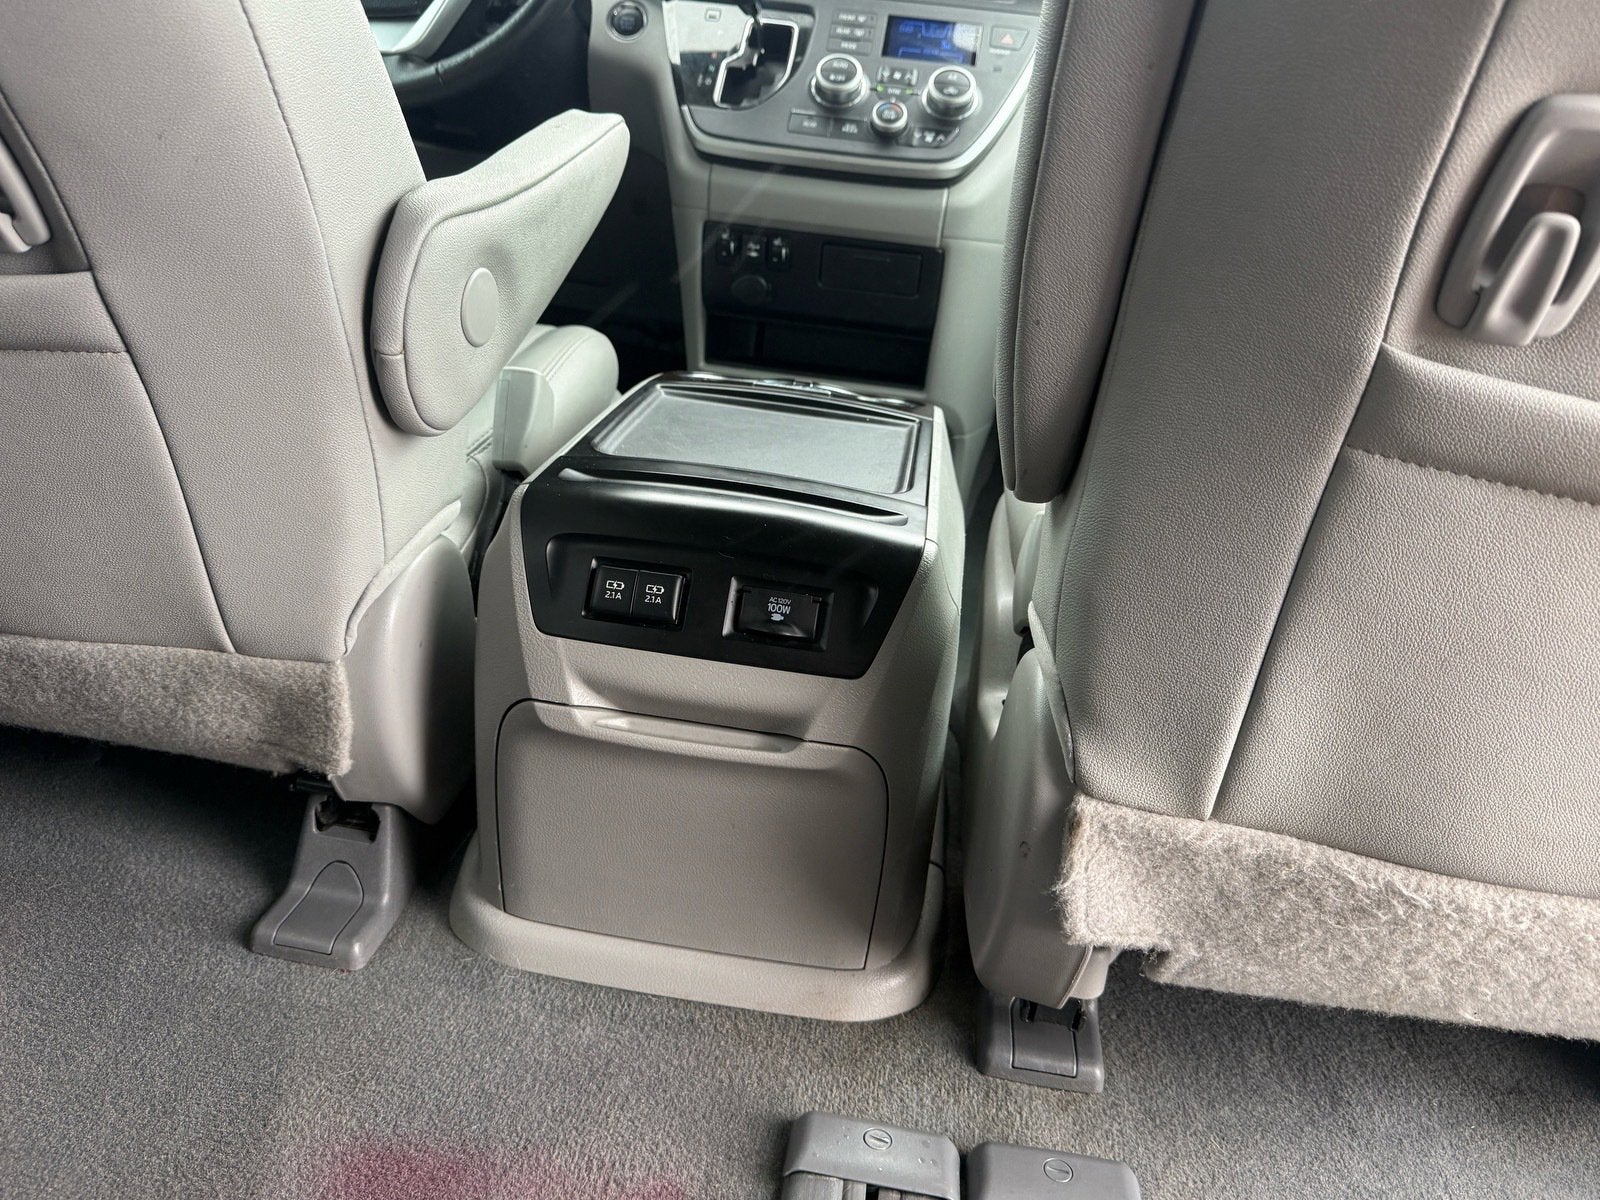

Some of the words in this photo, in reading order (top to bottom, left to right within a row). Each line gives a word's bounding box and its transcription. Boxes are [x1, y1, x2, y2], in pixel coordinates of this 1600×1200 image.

[604, 590, 622, 600] 2.1A
[644, 594, 662, 604] 2.1A
[767, 602, 791, 614] 100W
